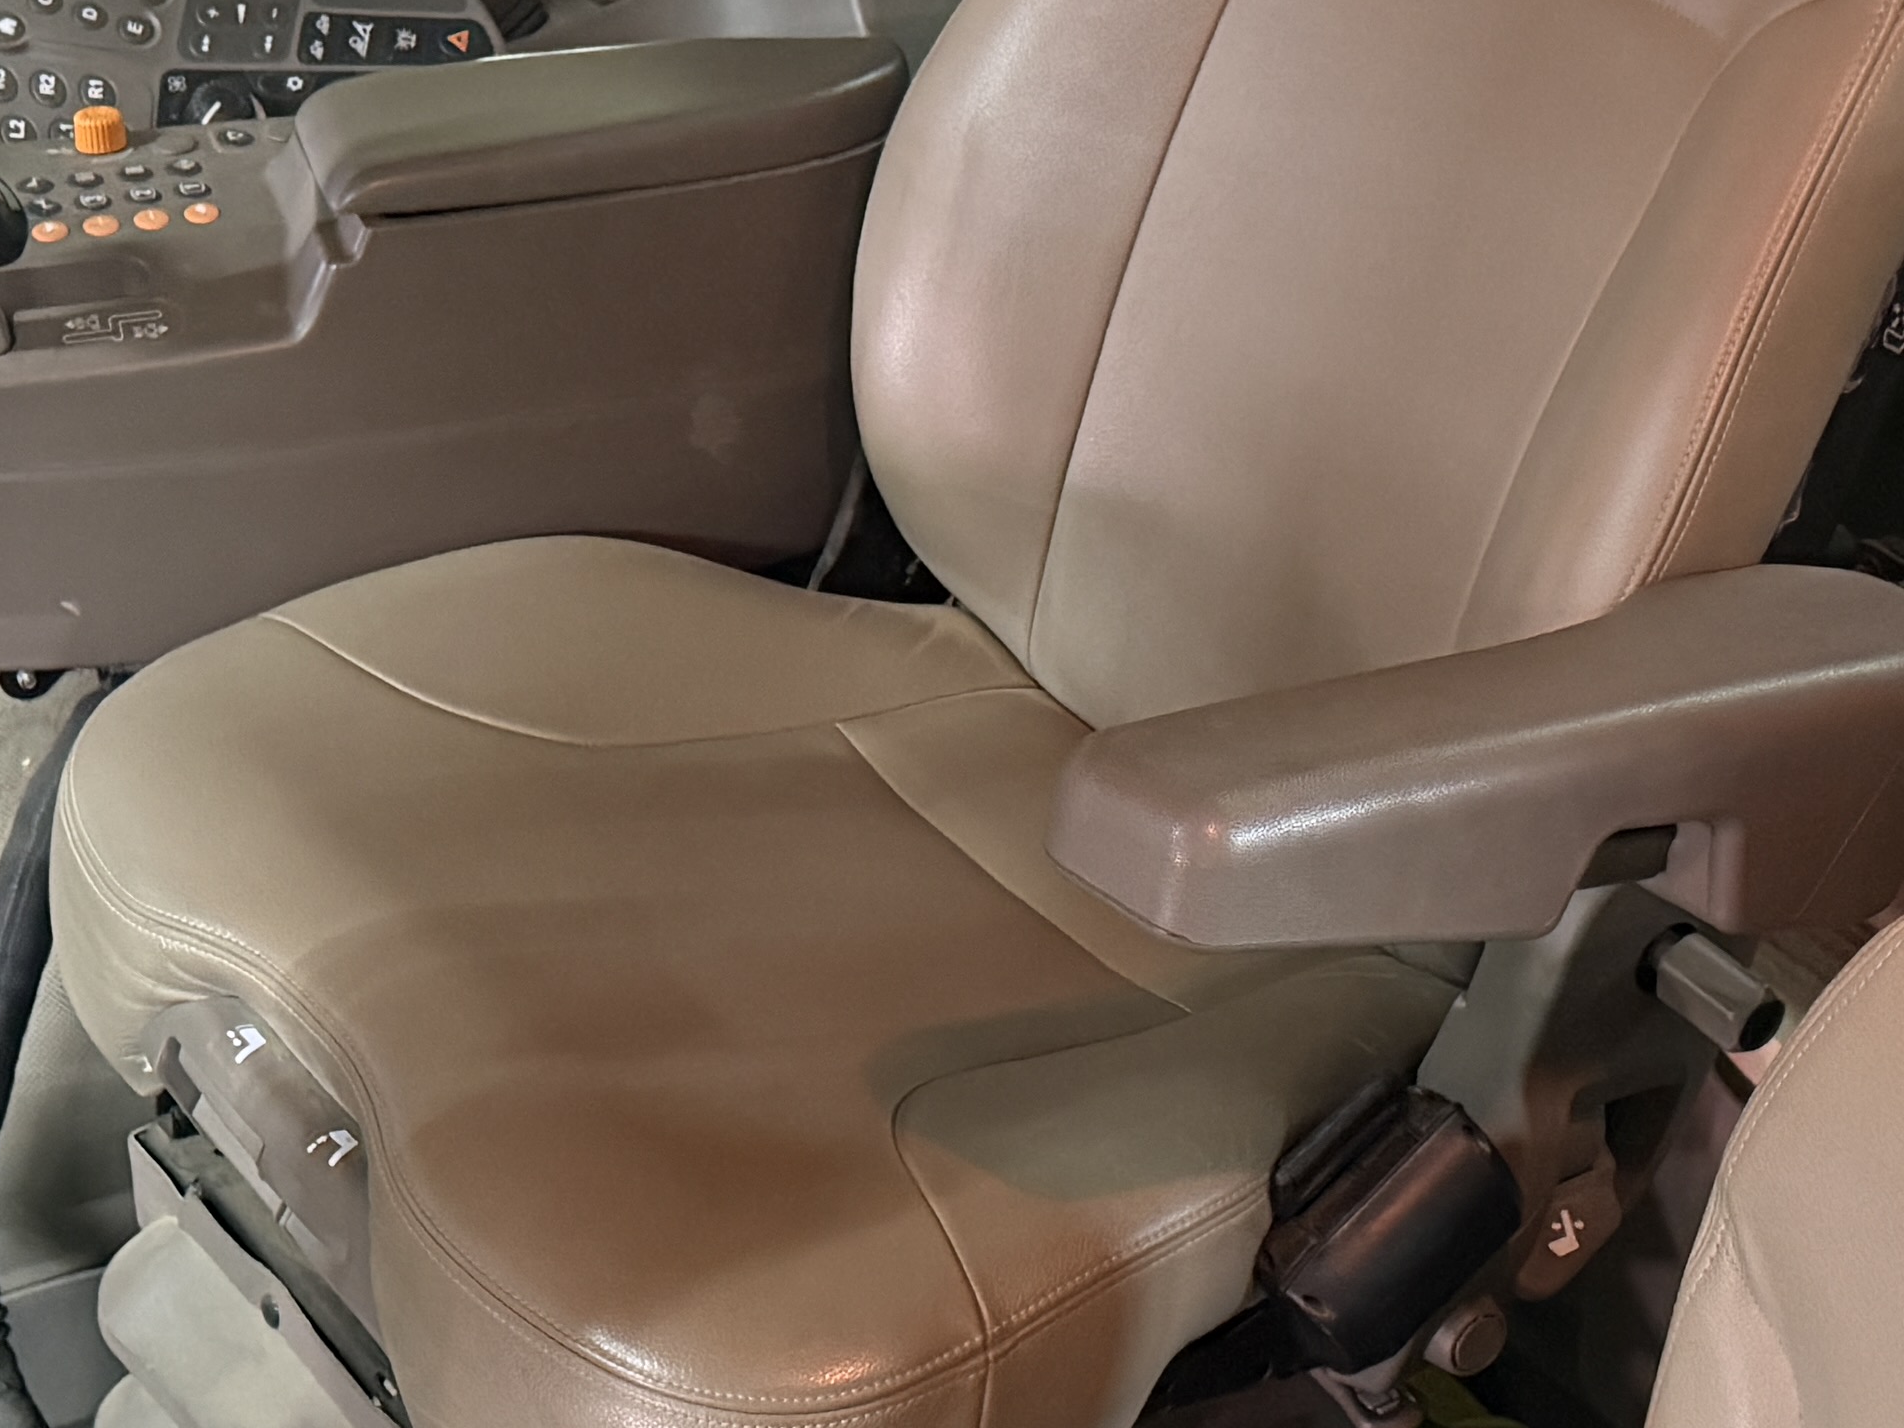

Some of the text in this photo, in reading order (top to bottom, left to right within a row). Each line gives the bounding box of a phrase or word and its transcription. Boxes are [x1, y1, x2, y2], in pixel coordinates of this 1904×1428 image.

[81, 8, 98, 21] D
[127, 20, 144, 35] E
[39, 74, 56, 96] R2
[88, 79, 104, 99] R1
[9, 119, 26, 139] L2
